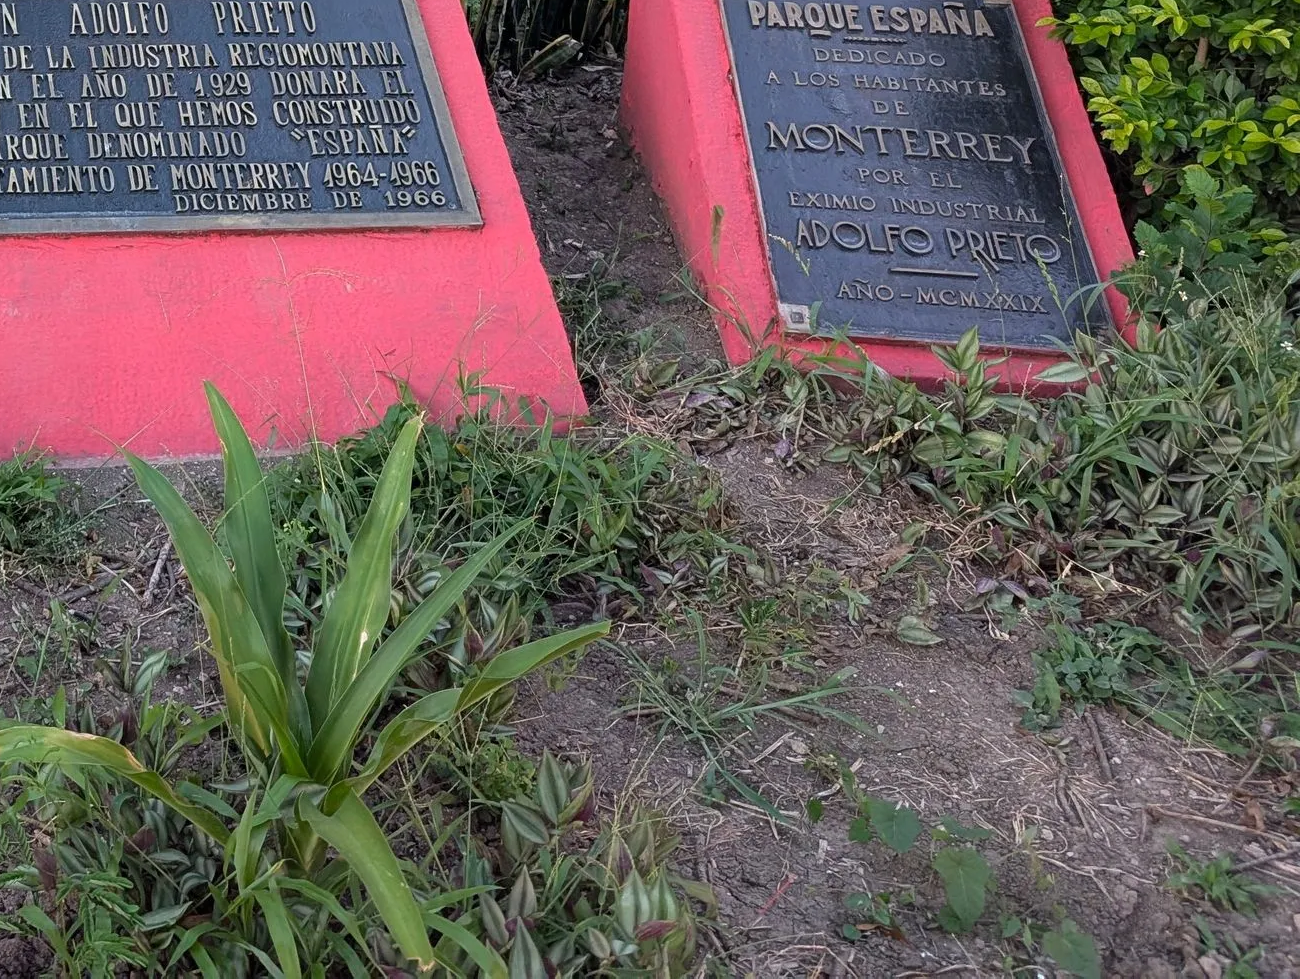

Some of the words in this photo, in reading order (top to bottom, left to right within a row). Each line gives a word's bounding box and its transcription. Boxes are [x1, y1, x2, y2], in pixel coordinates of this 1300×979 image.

[70, 1, 168, 35] ADOLFO
[212, 0, 316, 34] PRIETO
[748, 0, 863, 37] PARQUE
[870, 1, 994, 37] ESPAÑA
[3, 45, 34, 70] DE
[47, 45, 75, 69] LA
[88, 44, 219, 69] INDUSTRIA
[229, 41, 406, 67] REGIOMONTANA
[812, 47, 946, 67] DEDICADO
[32, 72, 64, 98] EL
[81, 70, 126, 98] AÑO
[147, 72, 177, 97] DE
[195, 72, 251, 97] 1.929
[271, 71, 367, 96] DONARA
[384, 71, 414, 95] EL
[766, 71, 781, 85] A
[793, 71, 840, 87] LOS
[854, 75, 1006, 97] HABITANTES
[18, 103, 50, 129] EN
[68, 102, 97, 128] EL
[115, 102, 164, 127] QUE
[180, 101, 257, 127] HEMOS
[273, 98, 420, 126] CONSTRUIDO
[872, 100, 910, 115] DE
[87, 131, 246, 159] DENOMINADO
[291, 125, 416, 155] "ESPAÑA"
[765, 121, 1036, 165] MONTERREY
[127, 164, 159, 192] DE
[171, 162, 312, 191] MONTERREY
[324, 160, 440, 187] 1964-1966
[856, 168, 909, 184] POR
[931, 172, 962, 189] EL
[175, 193, 312, 211] DICIEMBRE
[333, 192, 363, 208] DE
[384, 190, 445, 207] 1966
[789, 191, 876, 211] EXIMIO
[890, 197, 1045, 223] INDUSTRIAL
[796, 219, 934, 254] ADOLFO
[946, 228, 1061, 272] PRIETO
[837, 278, 893, 301] AÑO
[916, 286, 1048, 313] MCMXXIX
